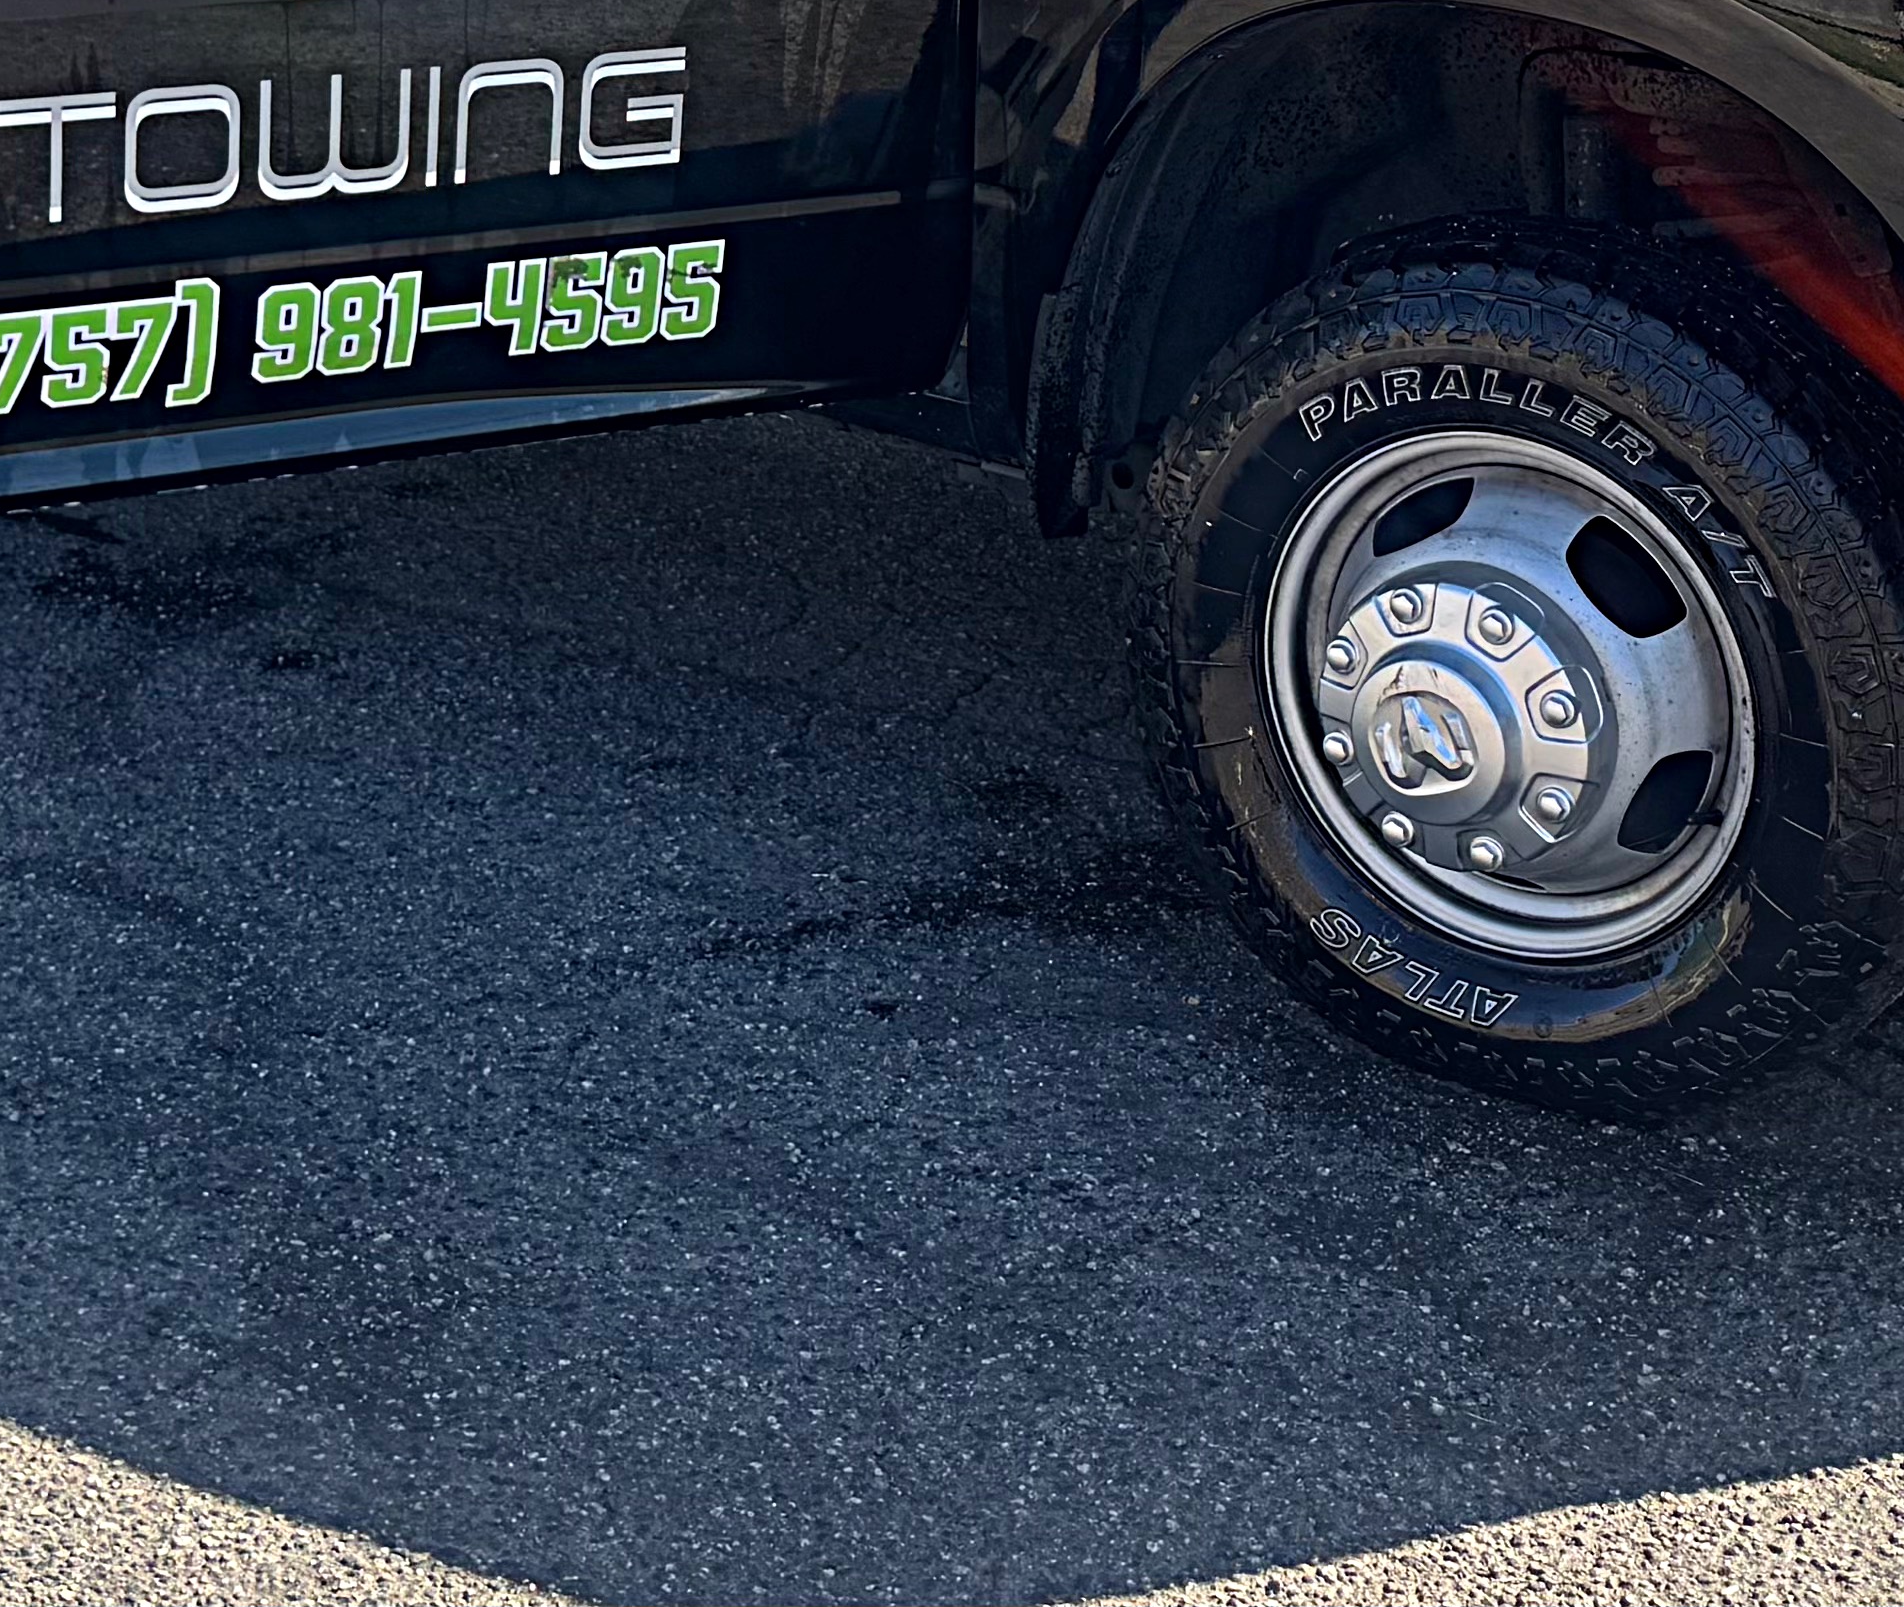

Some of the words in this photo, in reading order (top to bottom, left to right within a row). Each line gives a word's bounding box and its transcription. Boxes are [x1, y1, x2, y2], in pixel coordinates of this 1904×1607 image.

[251, 239, 727, 384] 981-4595
[1298, 364, 1657, 466] PARALLER
[1662, 484, 1776, 599] A/T
[1309, 908, 1519, 1027] ATLAS
